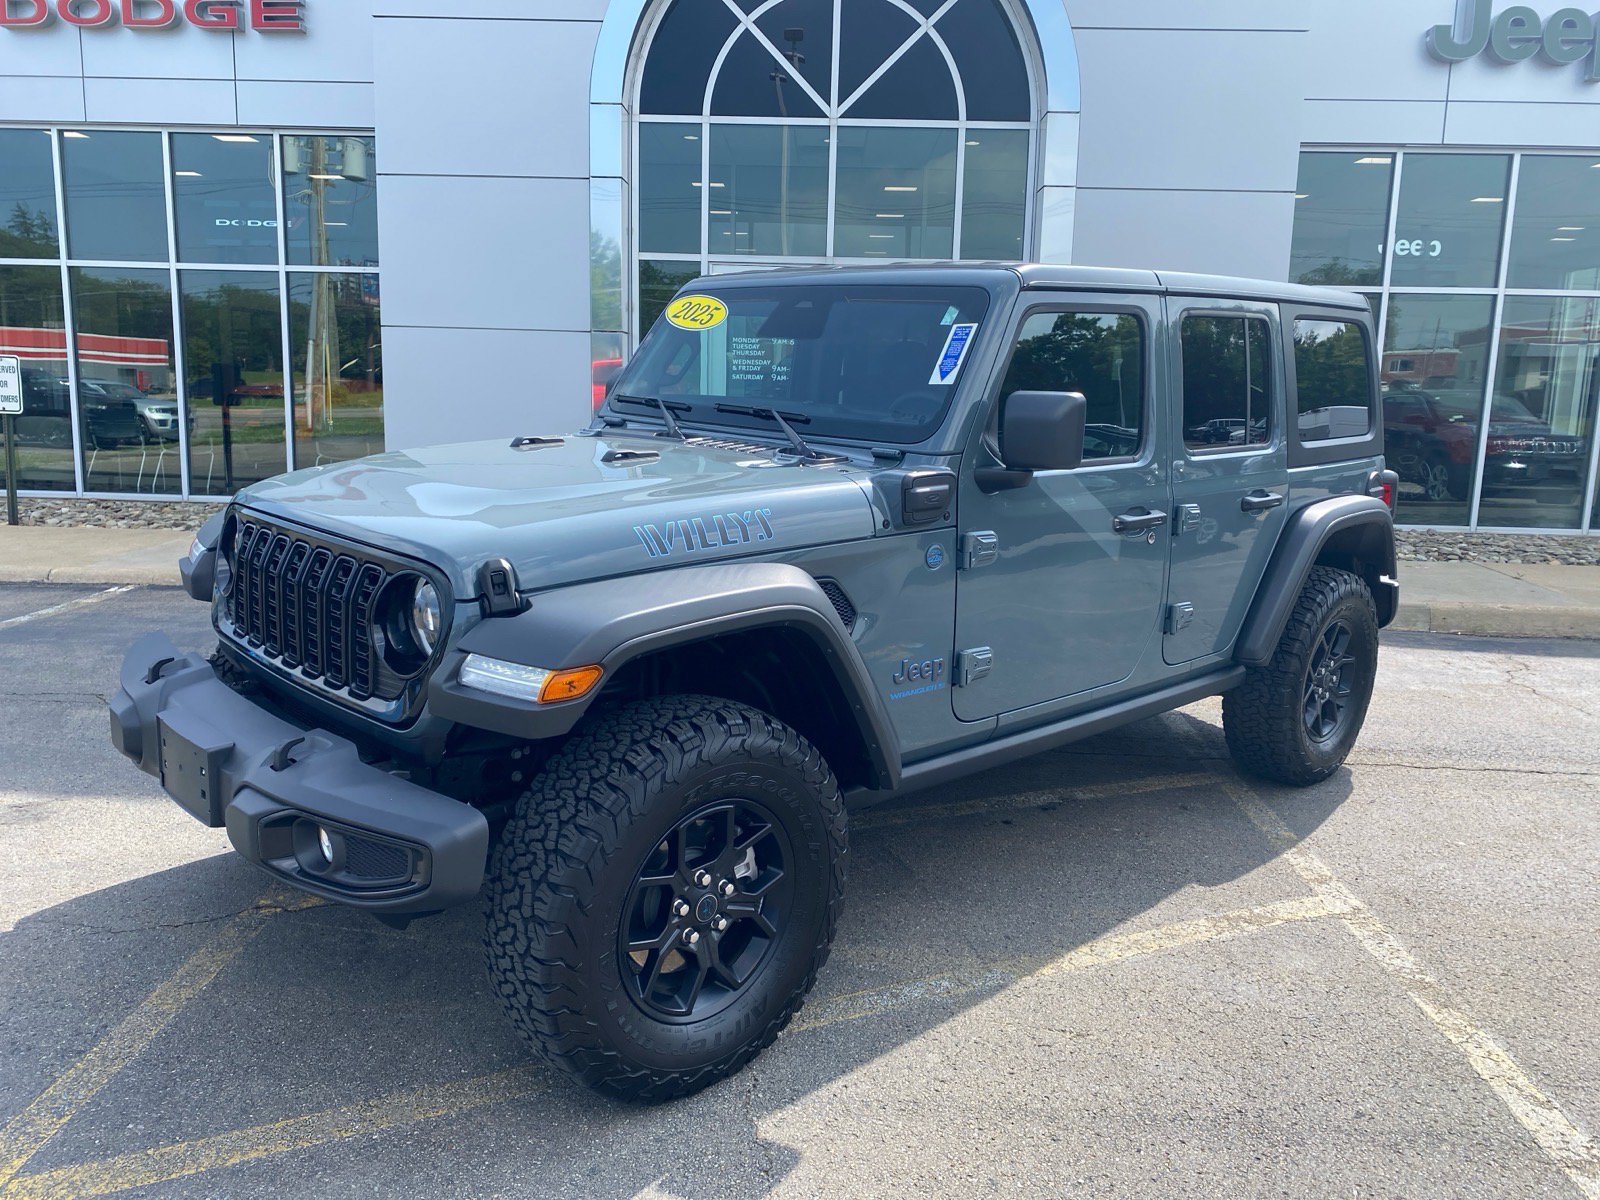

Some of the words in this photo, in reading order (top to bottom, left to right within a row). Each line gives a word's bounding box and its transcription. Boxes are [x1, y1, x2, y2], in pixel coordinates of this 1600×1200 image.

[0, 0, 302, 29] DODGE
[1430, 0, 1600, 80] Jee
[1378, 239, 1442, 257] ee
[671, 301, 722, 326] 2025
[633, 508, 774, 558] WILLYS
[892, 658, 944, 685] Jeep
